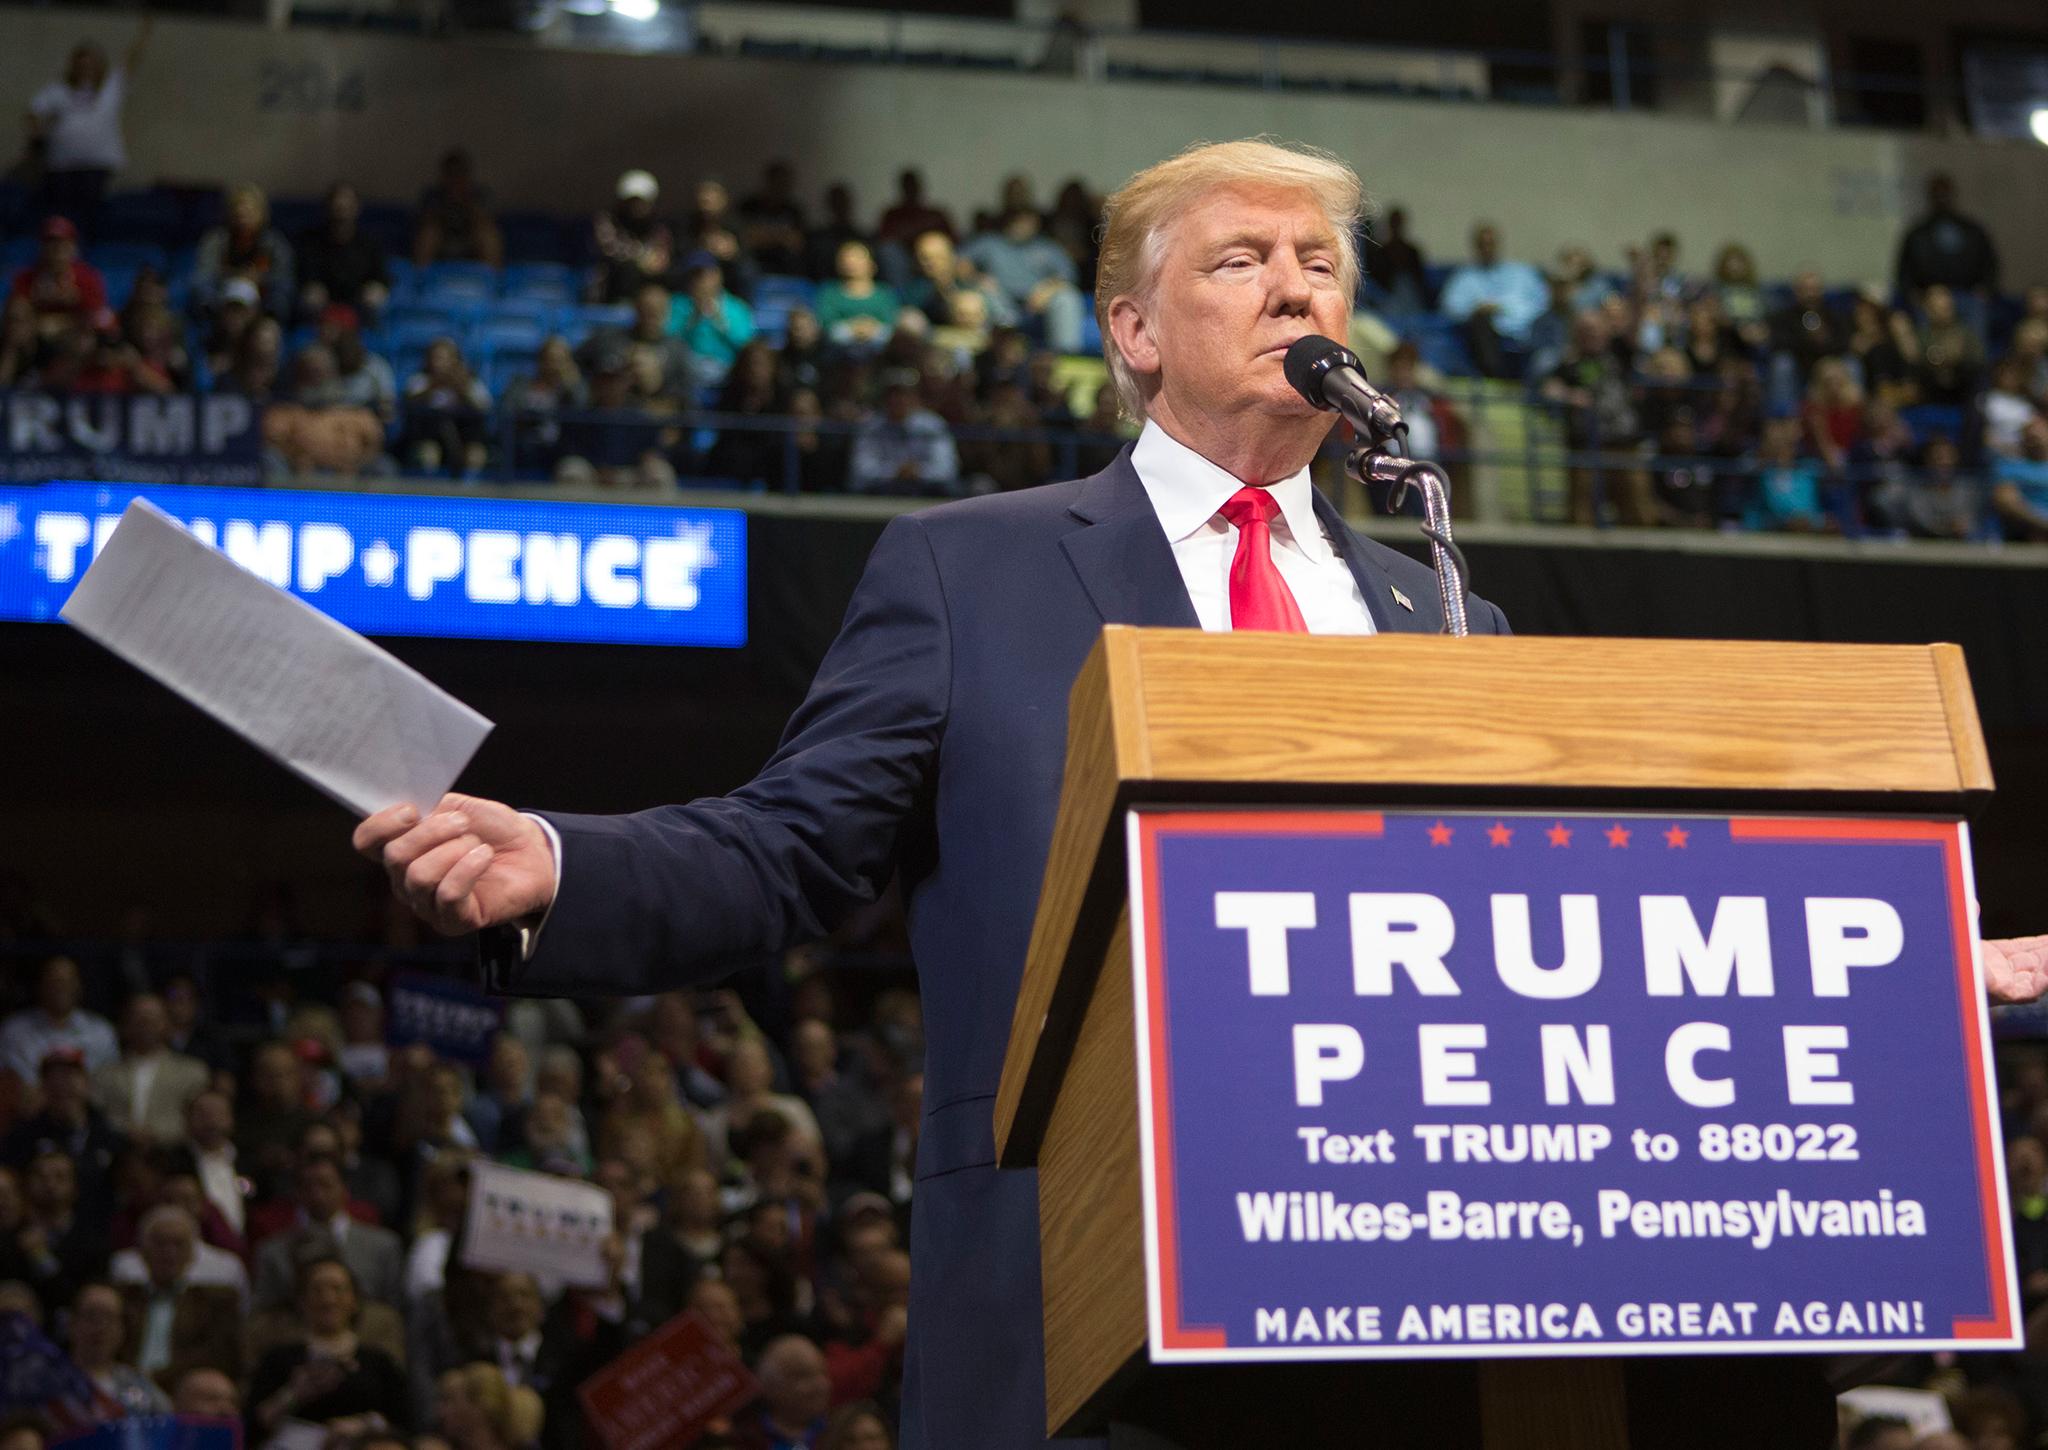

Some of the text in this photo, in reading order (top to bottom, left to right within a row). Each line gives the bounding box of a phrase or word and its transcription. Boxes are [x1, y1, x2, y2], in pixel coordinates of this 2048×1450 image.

[0, 392, 251, 455] RUMP
[34, 510, 700, 611] TMP PENCE
[1214, 891, 1905, 1001] TRUMP
[1292, 1021, 1856, 1109] PENCE
[1297, 1123, 1860, 1165] Text TRUMP to 88022
[1236, 1187, 1927, 1250] Wilkes-Barre, Pennsylvania
[1255, 1300, 1926, 1343] MAKE AMERICA GREAT AGAIN!
